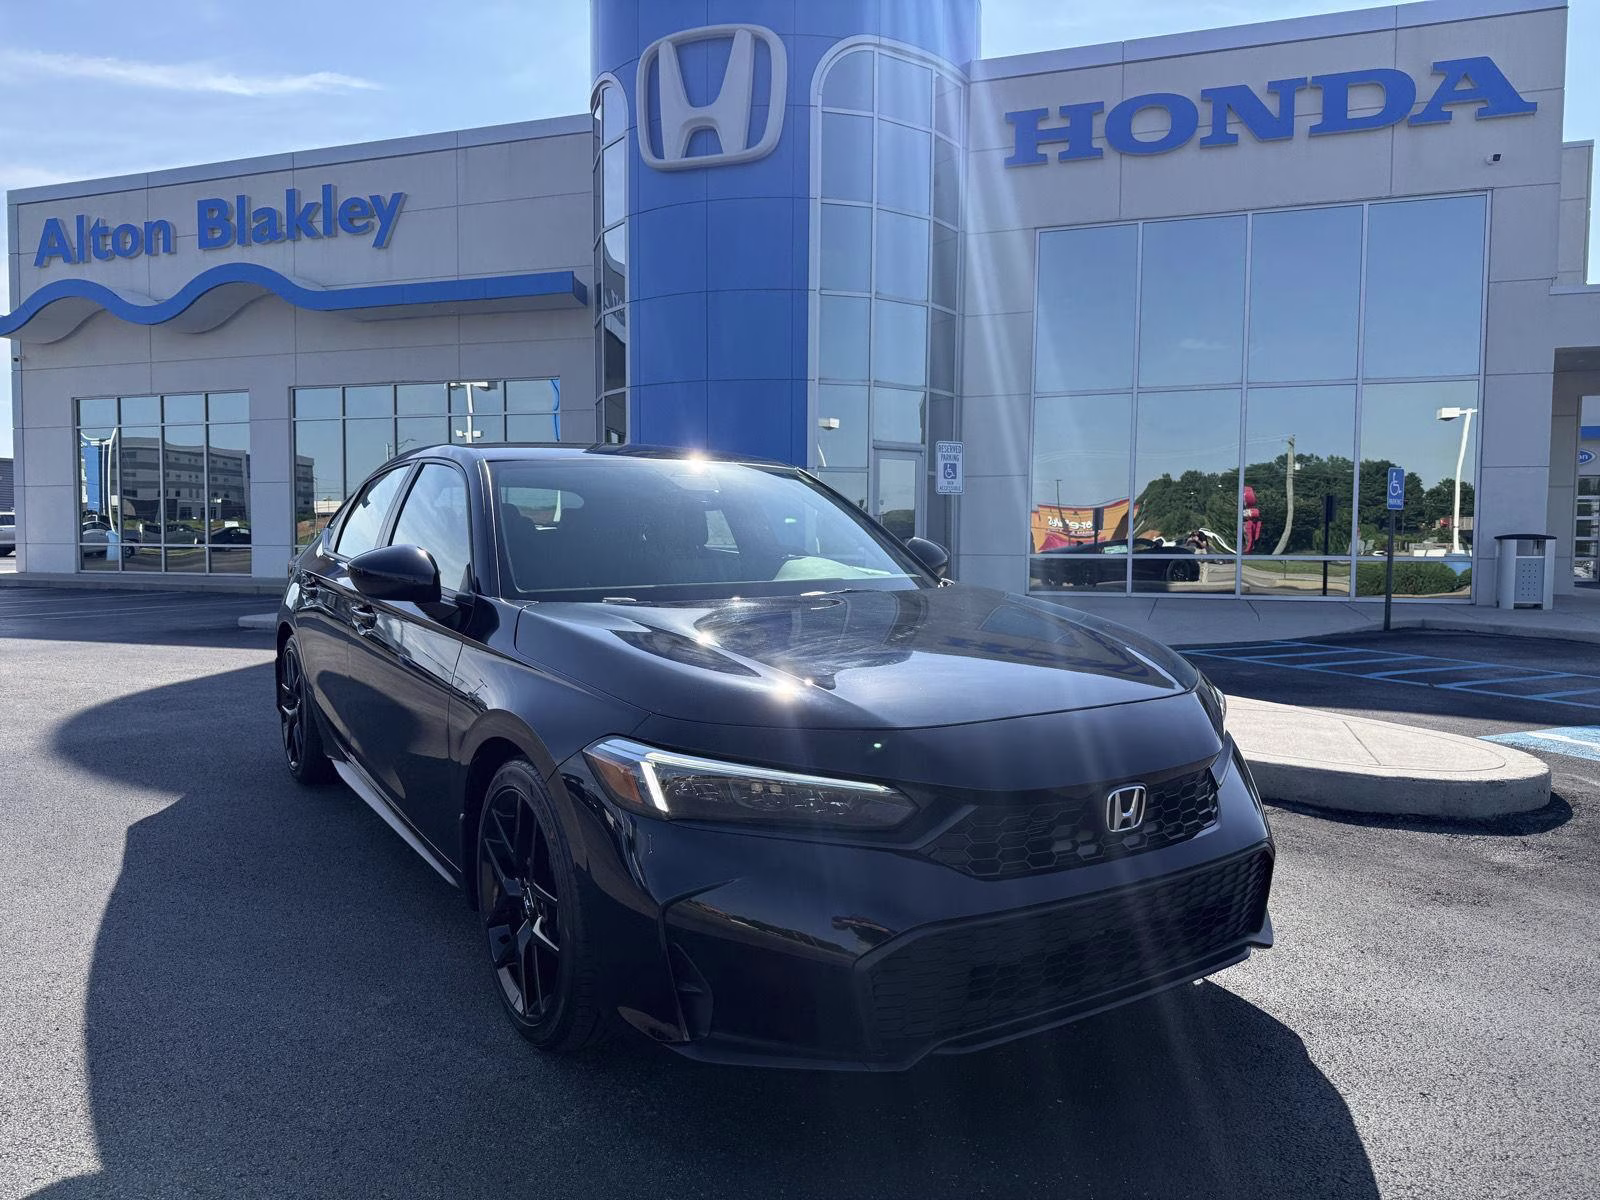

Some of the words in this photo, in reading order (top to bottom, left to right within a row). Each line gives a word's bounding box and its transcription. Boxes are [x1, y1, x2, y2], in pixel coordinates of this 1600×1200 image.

[1005, 56, 1537, 167] HONDA
[35, 214, 175, 268] Alton
[197, 184, 405, 249] Blakley
[939, 445, 961, 453] RESERVED
[941, 454, 960, 462] PARKING
